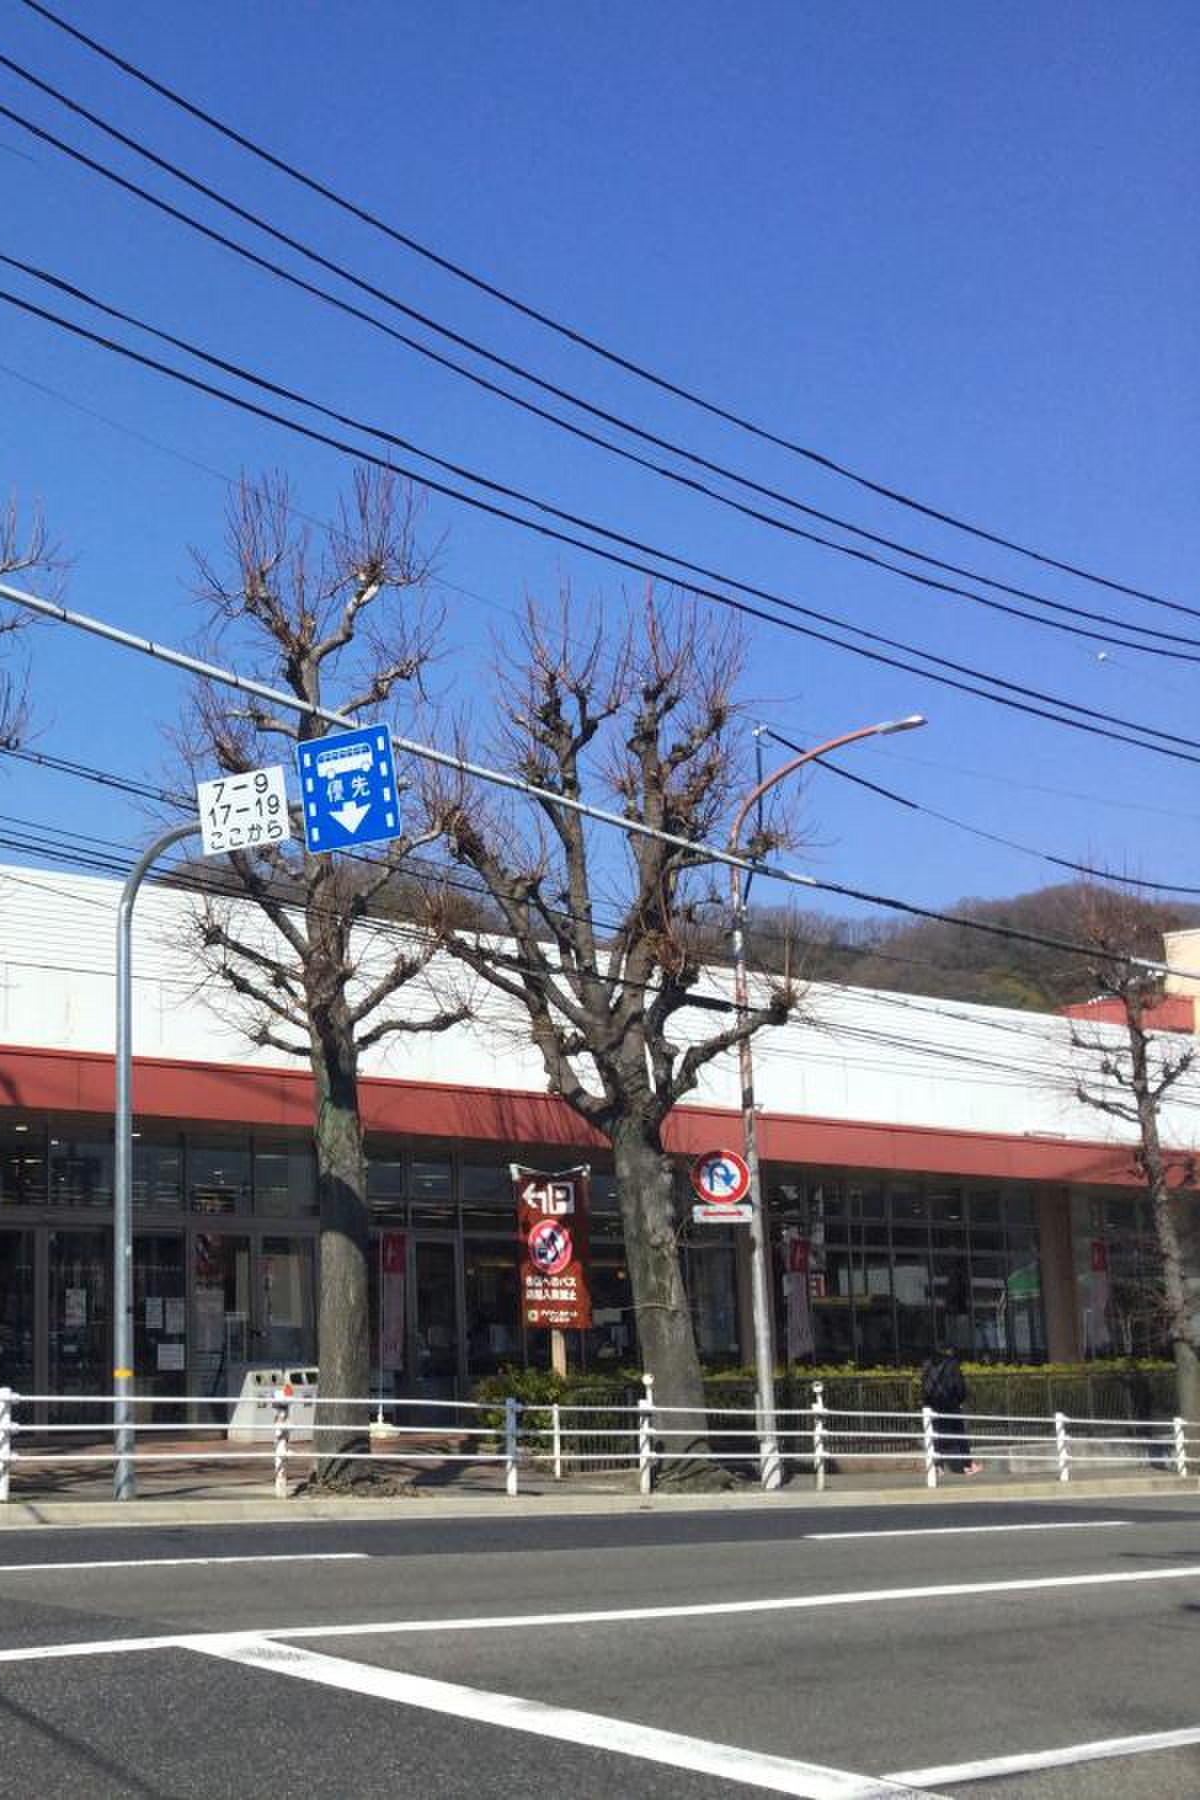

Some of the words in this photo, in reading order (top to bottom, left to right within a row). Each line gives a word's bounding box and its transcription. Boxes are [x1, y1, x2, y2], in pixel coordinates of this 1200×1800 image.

[326, 775, 372, 803] 優先
[210, 820, 283, 850] ここから
